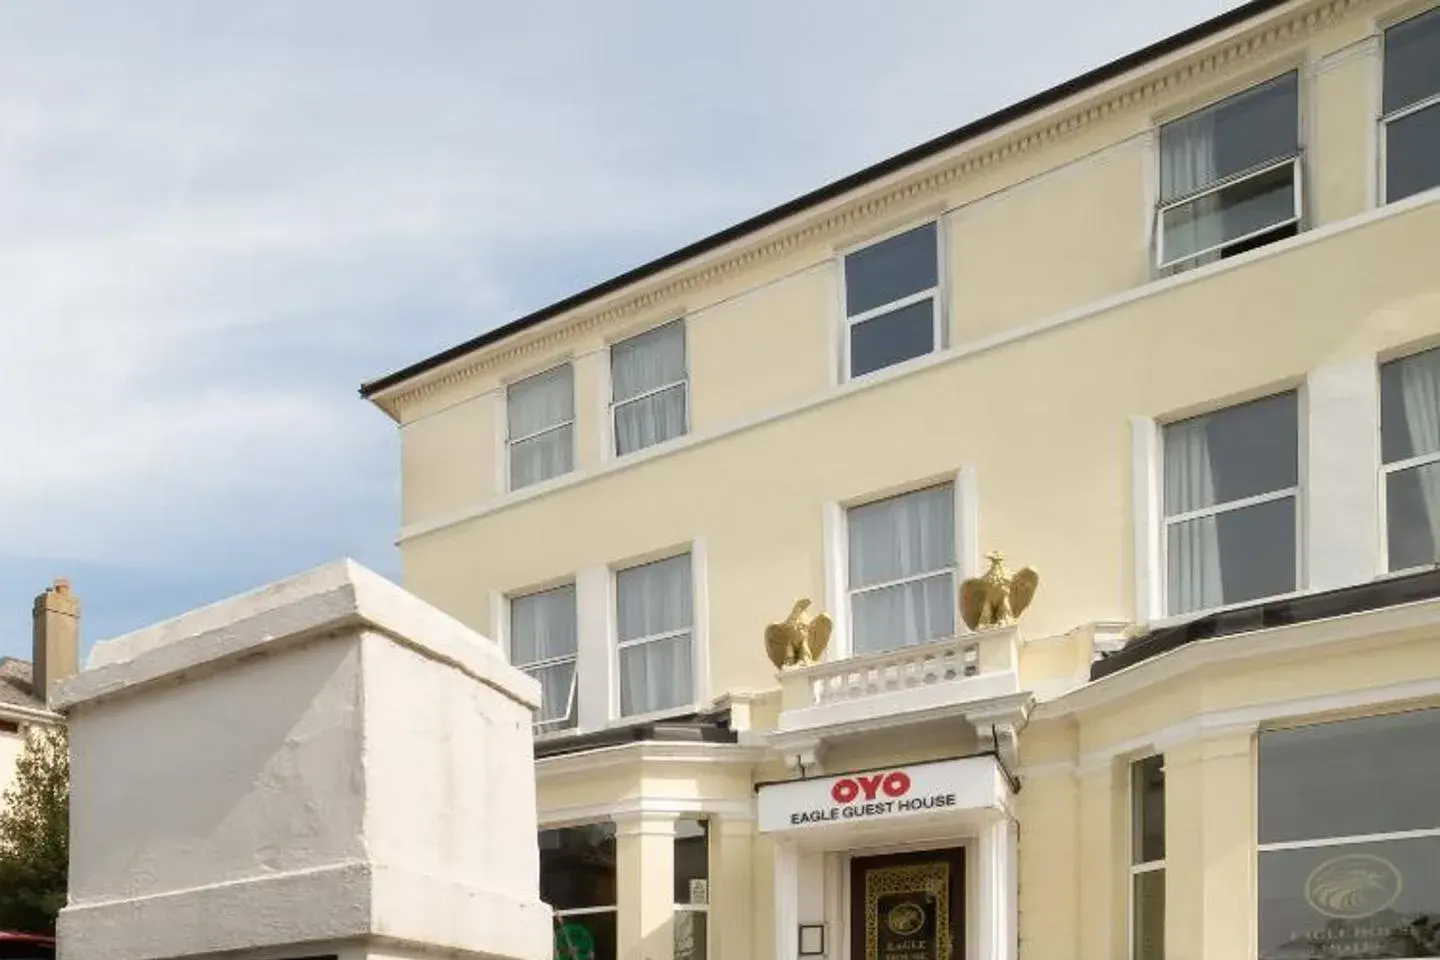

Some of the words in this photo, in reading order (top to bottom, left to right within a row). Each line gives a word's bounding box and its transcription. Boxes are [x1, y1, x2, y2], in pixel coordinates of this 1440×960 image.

[831, 771, 911, 803] OYO
[791, 807, 839, 825] EAGLE
[842, 803, 893, 818] GUEST
[898, 794, 956, 811] HOUSE
